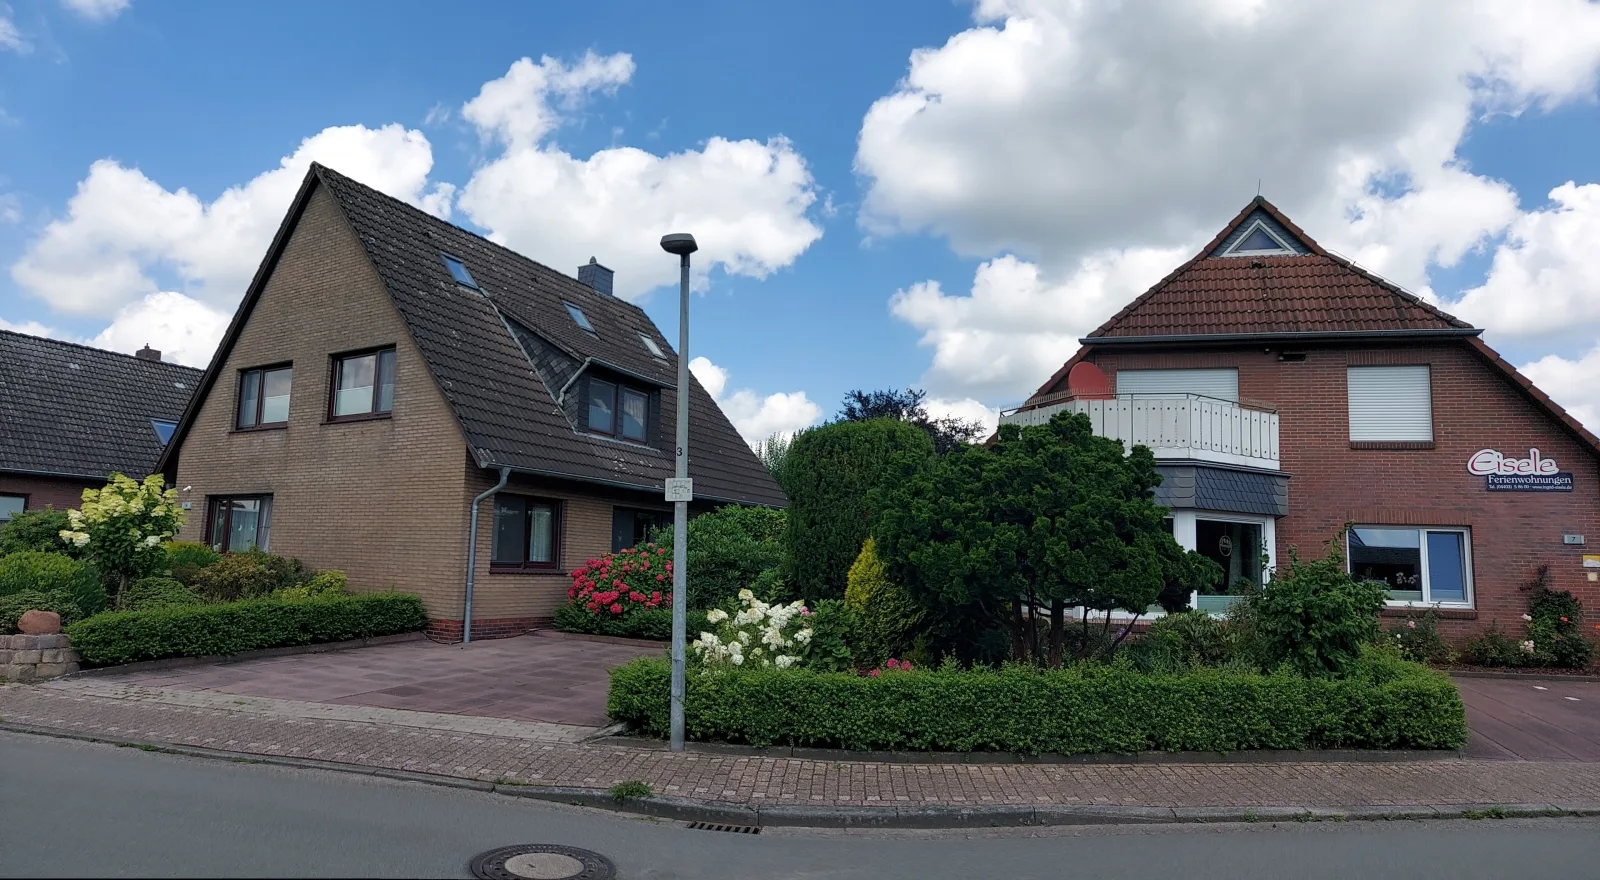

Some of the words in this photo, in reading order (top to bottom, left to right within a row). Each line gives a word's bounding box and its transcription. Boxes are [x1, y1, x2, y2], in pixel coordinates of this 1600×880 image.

[676, 447, 683, 456] 3
[1470, 450, 1557, 473] Eisele
[1488, 474, 1572, 485] Ferienwohnungen
